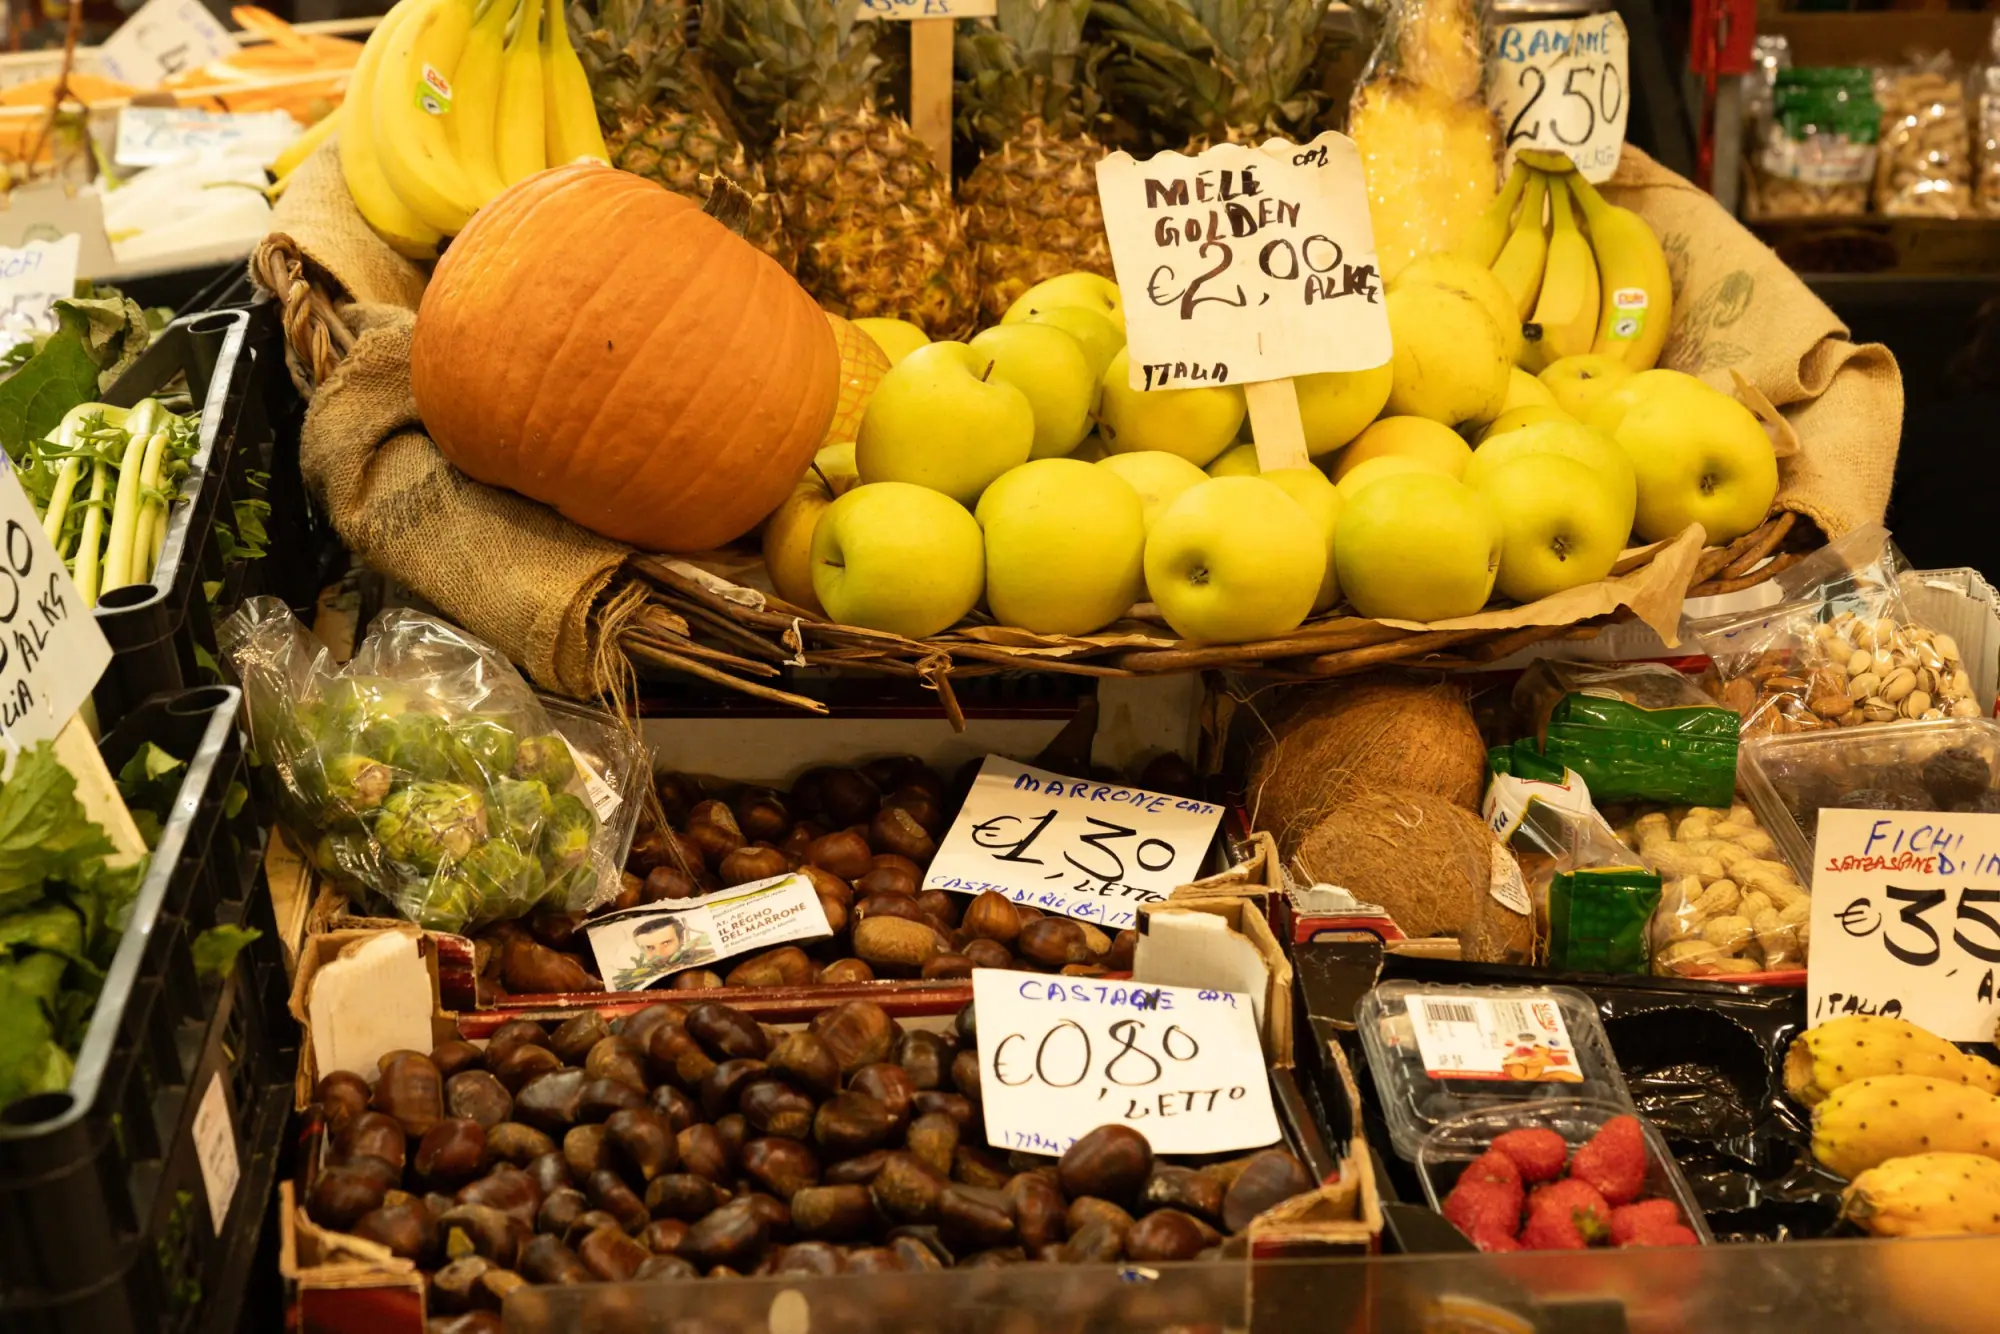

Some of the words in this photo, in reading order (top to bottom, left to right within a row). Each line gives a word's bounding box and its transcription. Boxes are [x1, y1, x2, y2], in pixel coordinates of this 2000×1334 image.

[1155, 198, 1301, 247] GOLDEN
[1147, 234, 1343, 320] €2,00
[1014, 773, 1172, 813] MARRONE
[971, 808, 1176, 884] €1,30
[1864, 820, 1964, 856] FICHI
[719, 927, 730, 937] IL
[731, 907, 772, 931] REGNO
[721, 932, 744, 944] DEL
[746, 902, 806, 933] MARRONE
[993, 1018, 1199, 1100] €0,80
